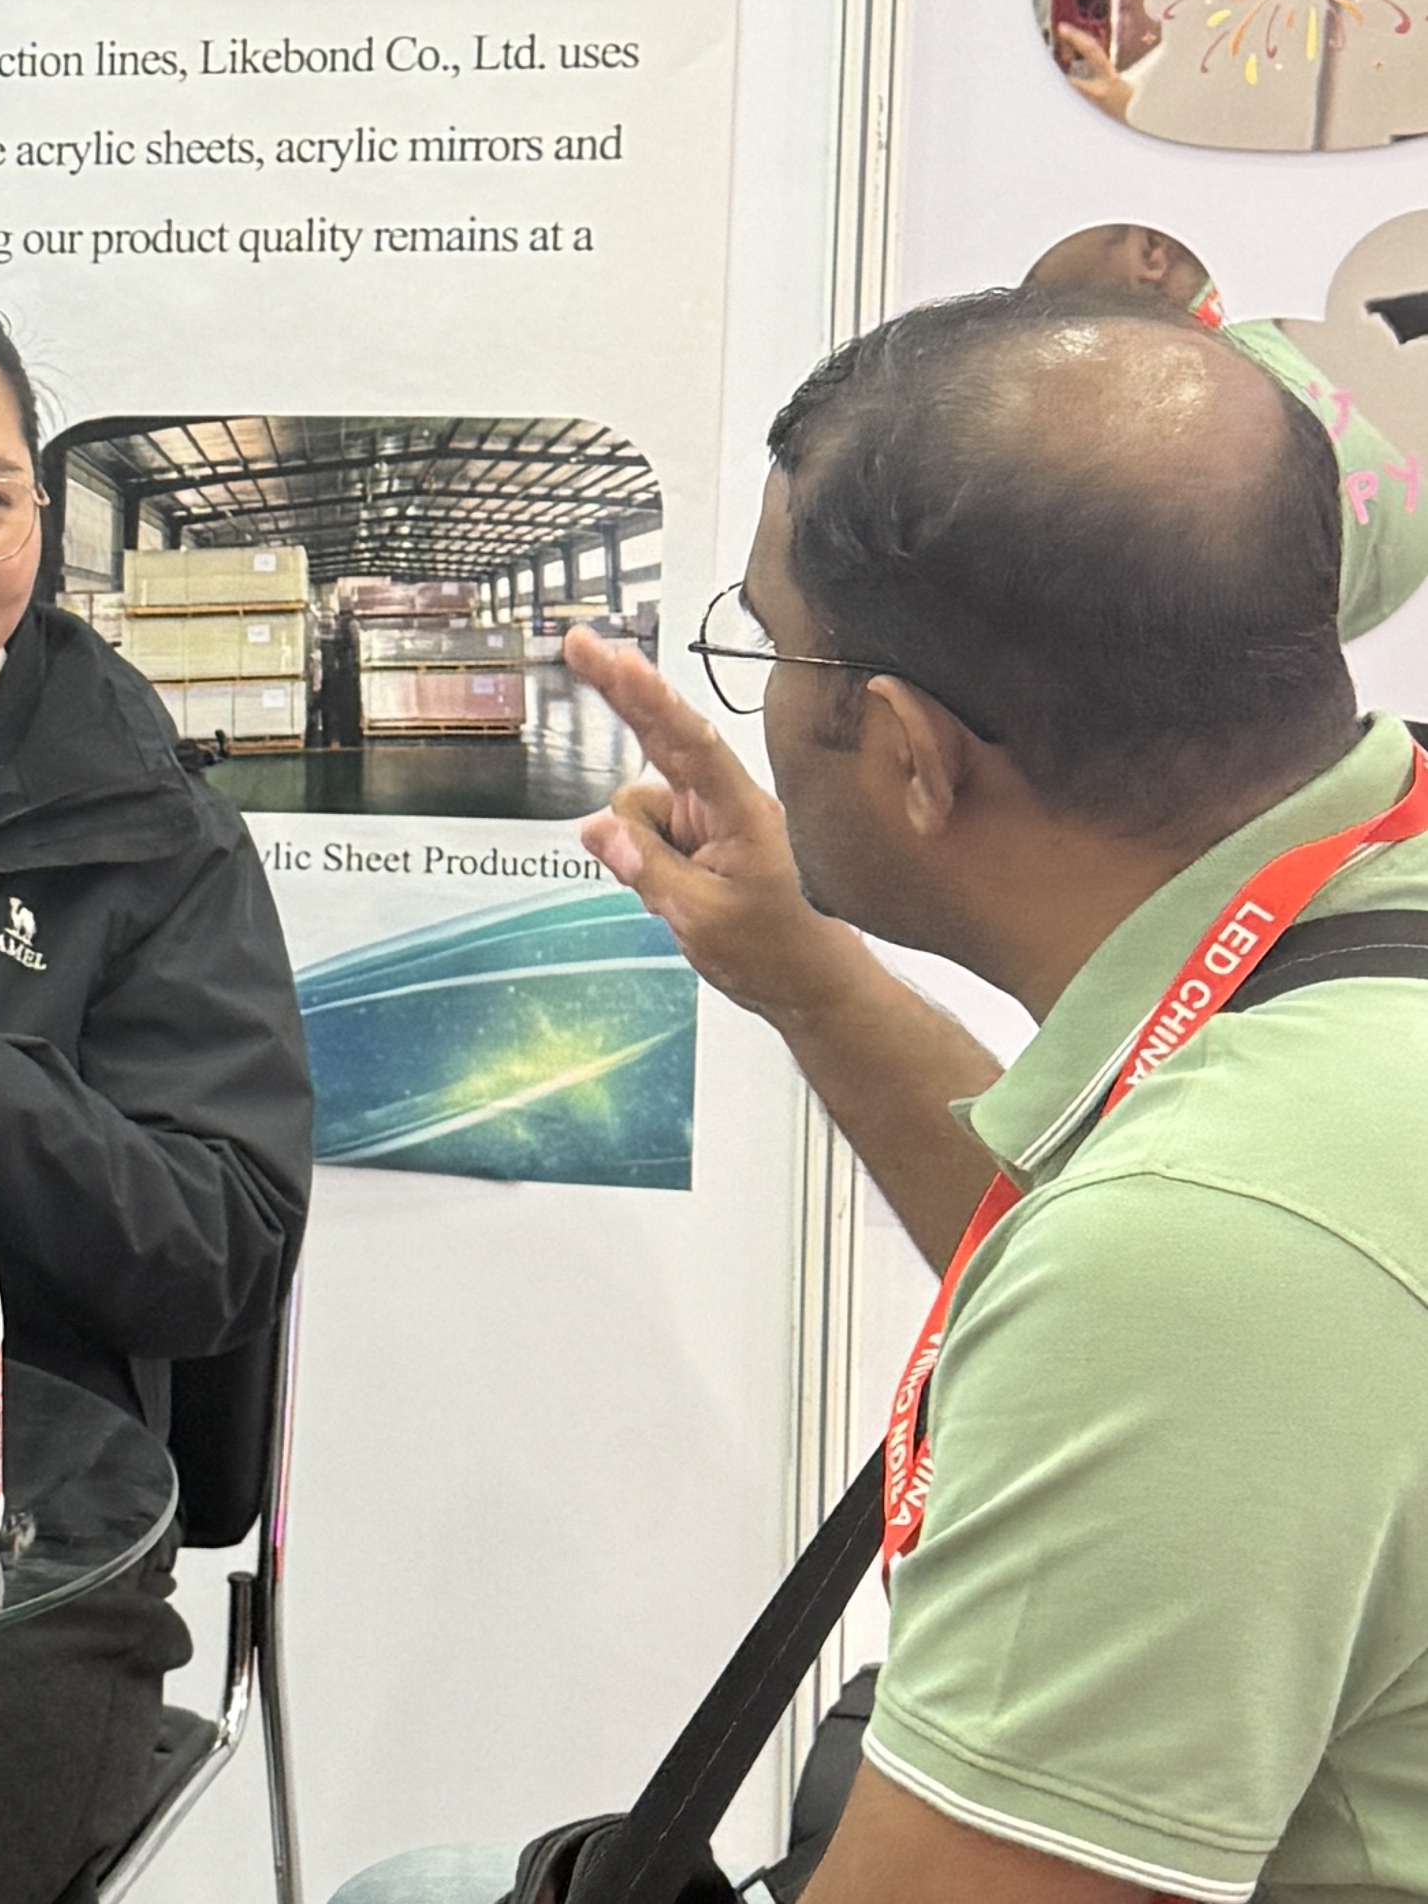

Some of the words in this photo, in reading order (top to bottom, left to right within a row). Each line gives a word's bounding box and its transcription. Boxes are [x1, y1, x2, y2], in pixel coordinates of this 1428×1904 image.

[96, 40, 188, 82] lines,
[200, 35, 375, 75] Likebond
[385, 35, 461, 78] Co.,
[473, 33, 546, 71] Ltd.
[559, 42, 640, 70] uses
[15, 130, 136, 176] acrylic
[146, 129, 265, 171] sheets,
[275, 126, 398, 173] acrylic
[408, 125, 544, 163] mirrors
[553, 123, 623, 161] and
[22, 230, 84, 255] our
[91, 218, 229, 265] product
[238, 216, 364, 264] quality
[374, 215, 519, 253] remains
[529, 222, 563, 252] at
[572, 227, 594, 252] a
[323, 842, 411, 874] Sheet
[424, 845, 602, 881] Production
[1205, 901, 1275, 974] LED
